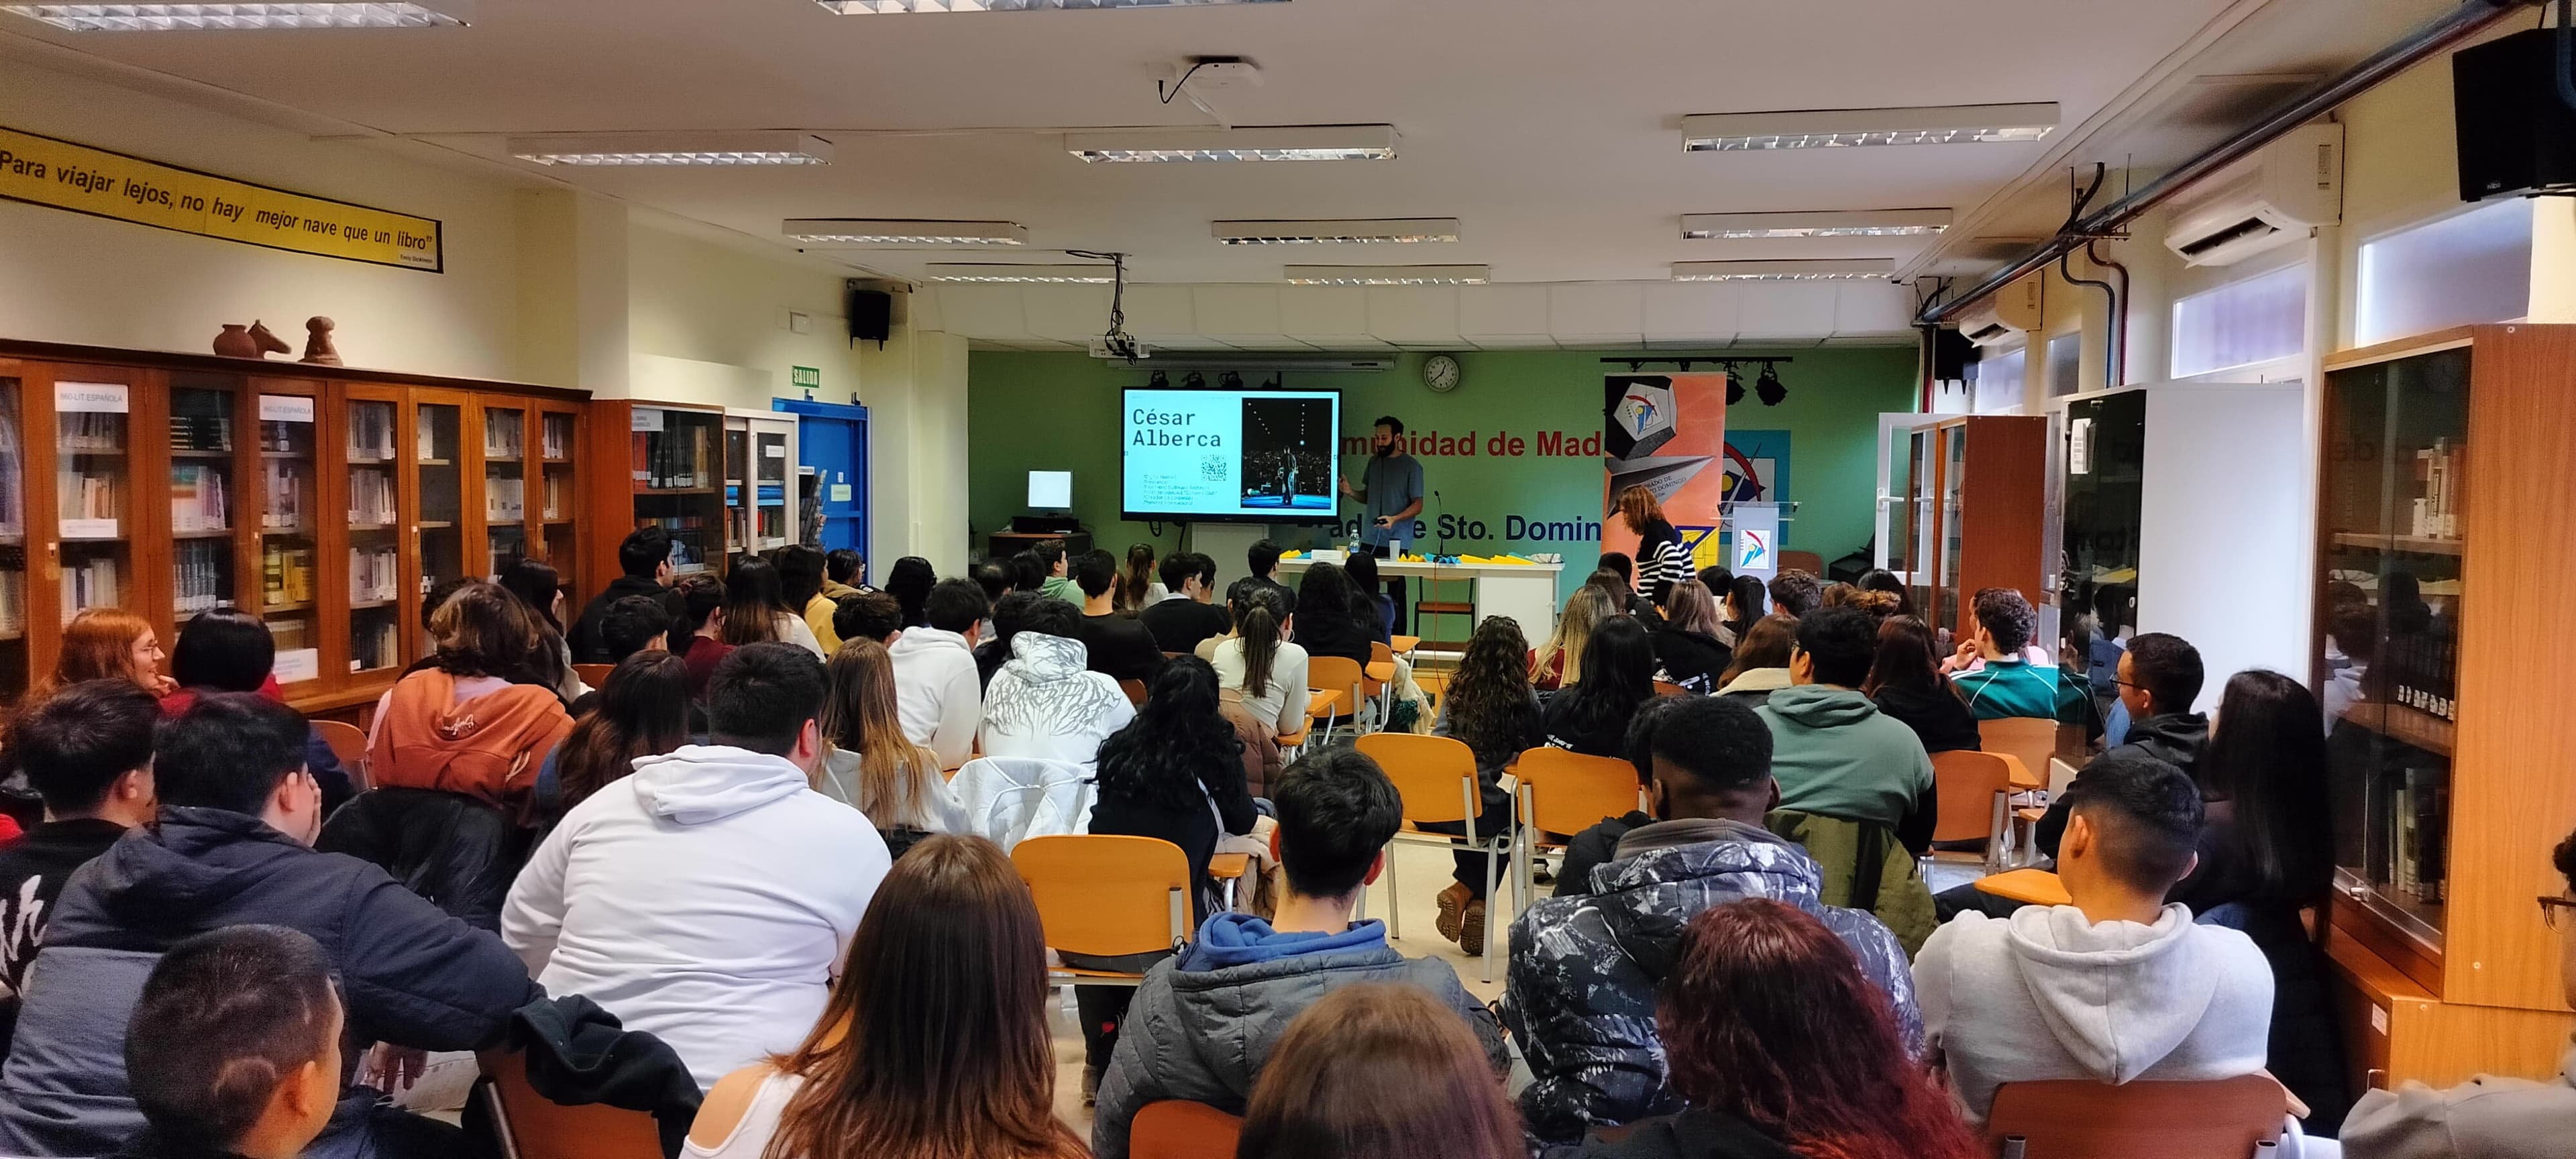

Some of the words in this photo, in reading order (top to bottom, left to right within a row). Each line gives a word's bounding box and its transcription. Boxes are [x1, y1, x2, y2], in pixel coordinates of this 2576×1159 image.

[0, 150, 46, 178] Para
[58, 166, 115, 193] viajar
[123, 178, 173, 209] lejos,
[181, 195, 204, 211] no
[212, 197, 244, 223] hay
[256, 210, 299, 229] mejor
[303, 219, 337, 235] nave
[343, 225, 368, 242] que
[374, 231, 390, 244] un
[794, 368, 818, 386] SALIDA
[1132, 408, 1196, 425] César
[1132, 429, 1221, 447] Alberca
[1487, 431, 1525, 457] de
[1537, 431, 1601, 457] Mad
[1658, 477, 1686, 491] DOMINGO
[1436, 514, 1494, 539] Sto.
[1505, 514, 1601, 541] Domin
